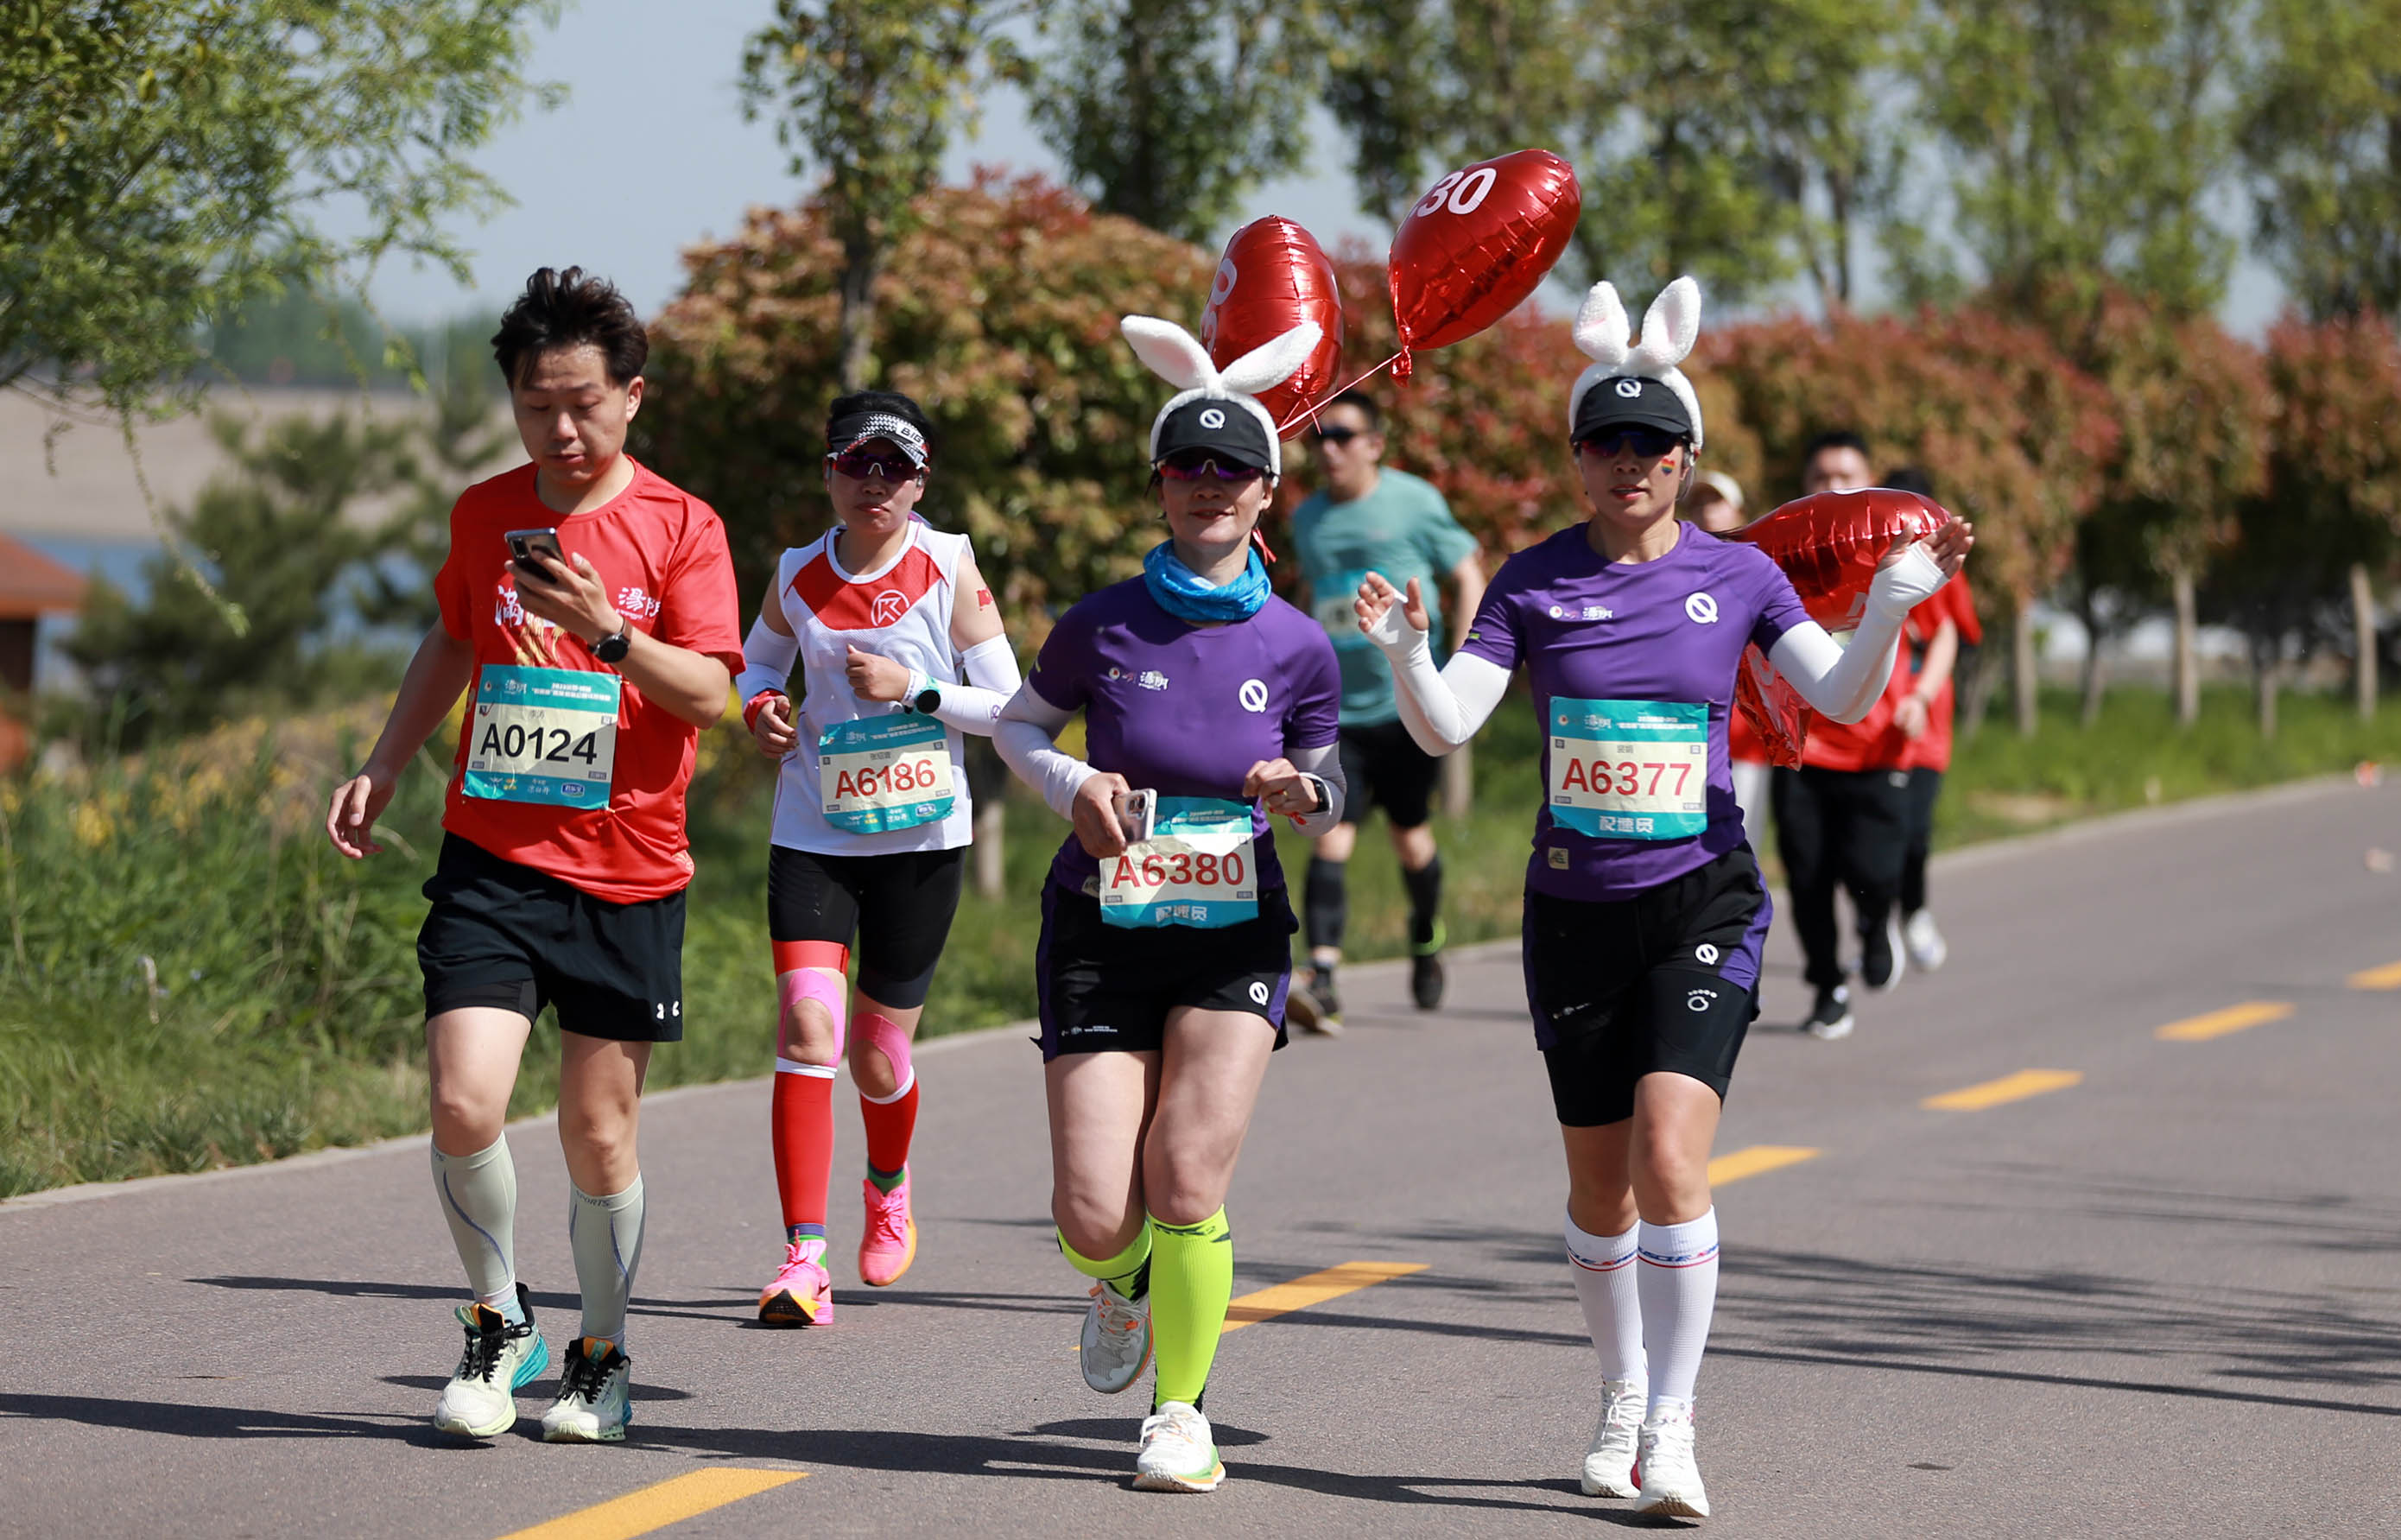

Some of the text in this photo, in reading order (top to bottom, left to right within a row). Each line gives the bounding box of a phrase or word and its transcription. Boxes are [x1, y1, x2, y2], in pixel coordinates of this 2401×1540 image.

[1417, 168, 1497, 217] 30
[901, 427, 924, 443] BIG
[480, 723, 598, 765] A0124
[835, 759, 935, 799] A6186
[1562, 757, 1691, 795] A6377
[1112, 852, 1244, 889] A6380
